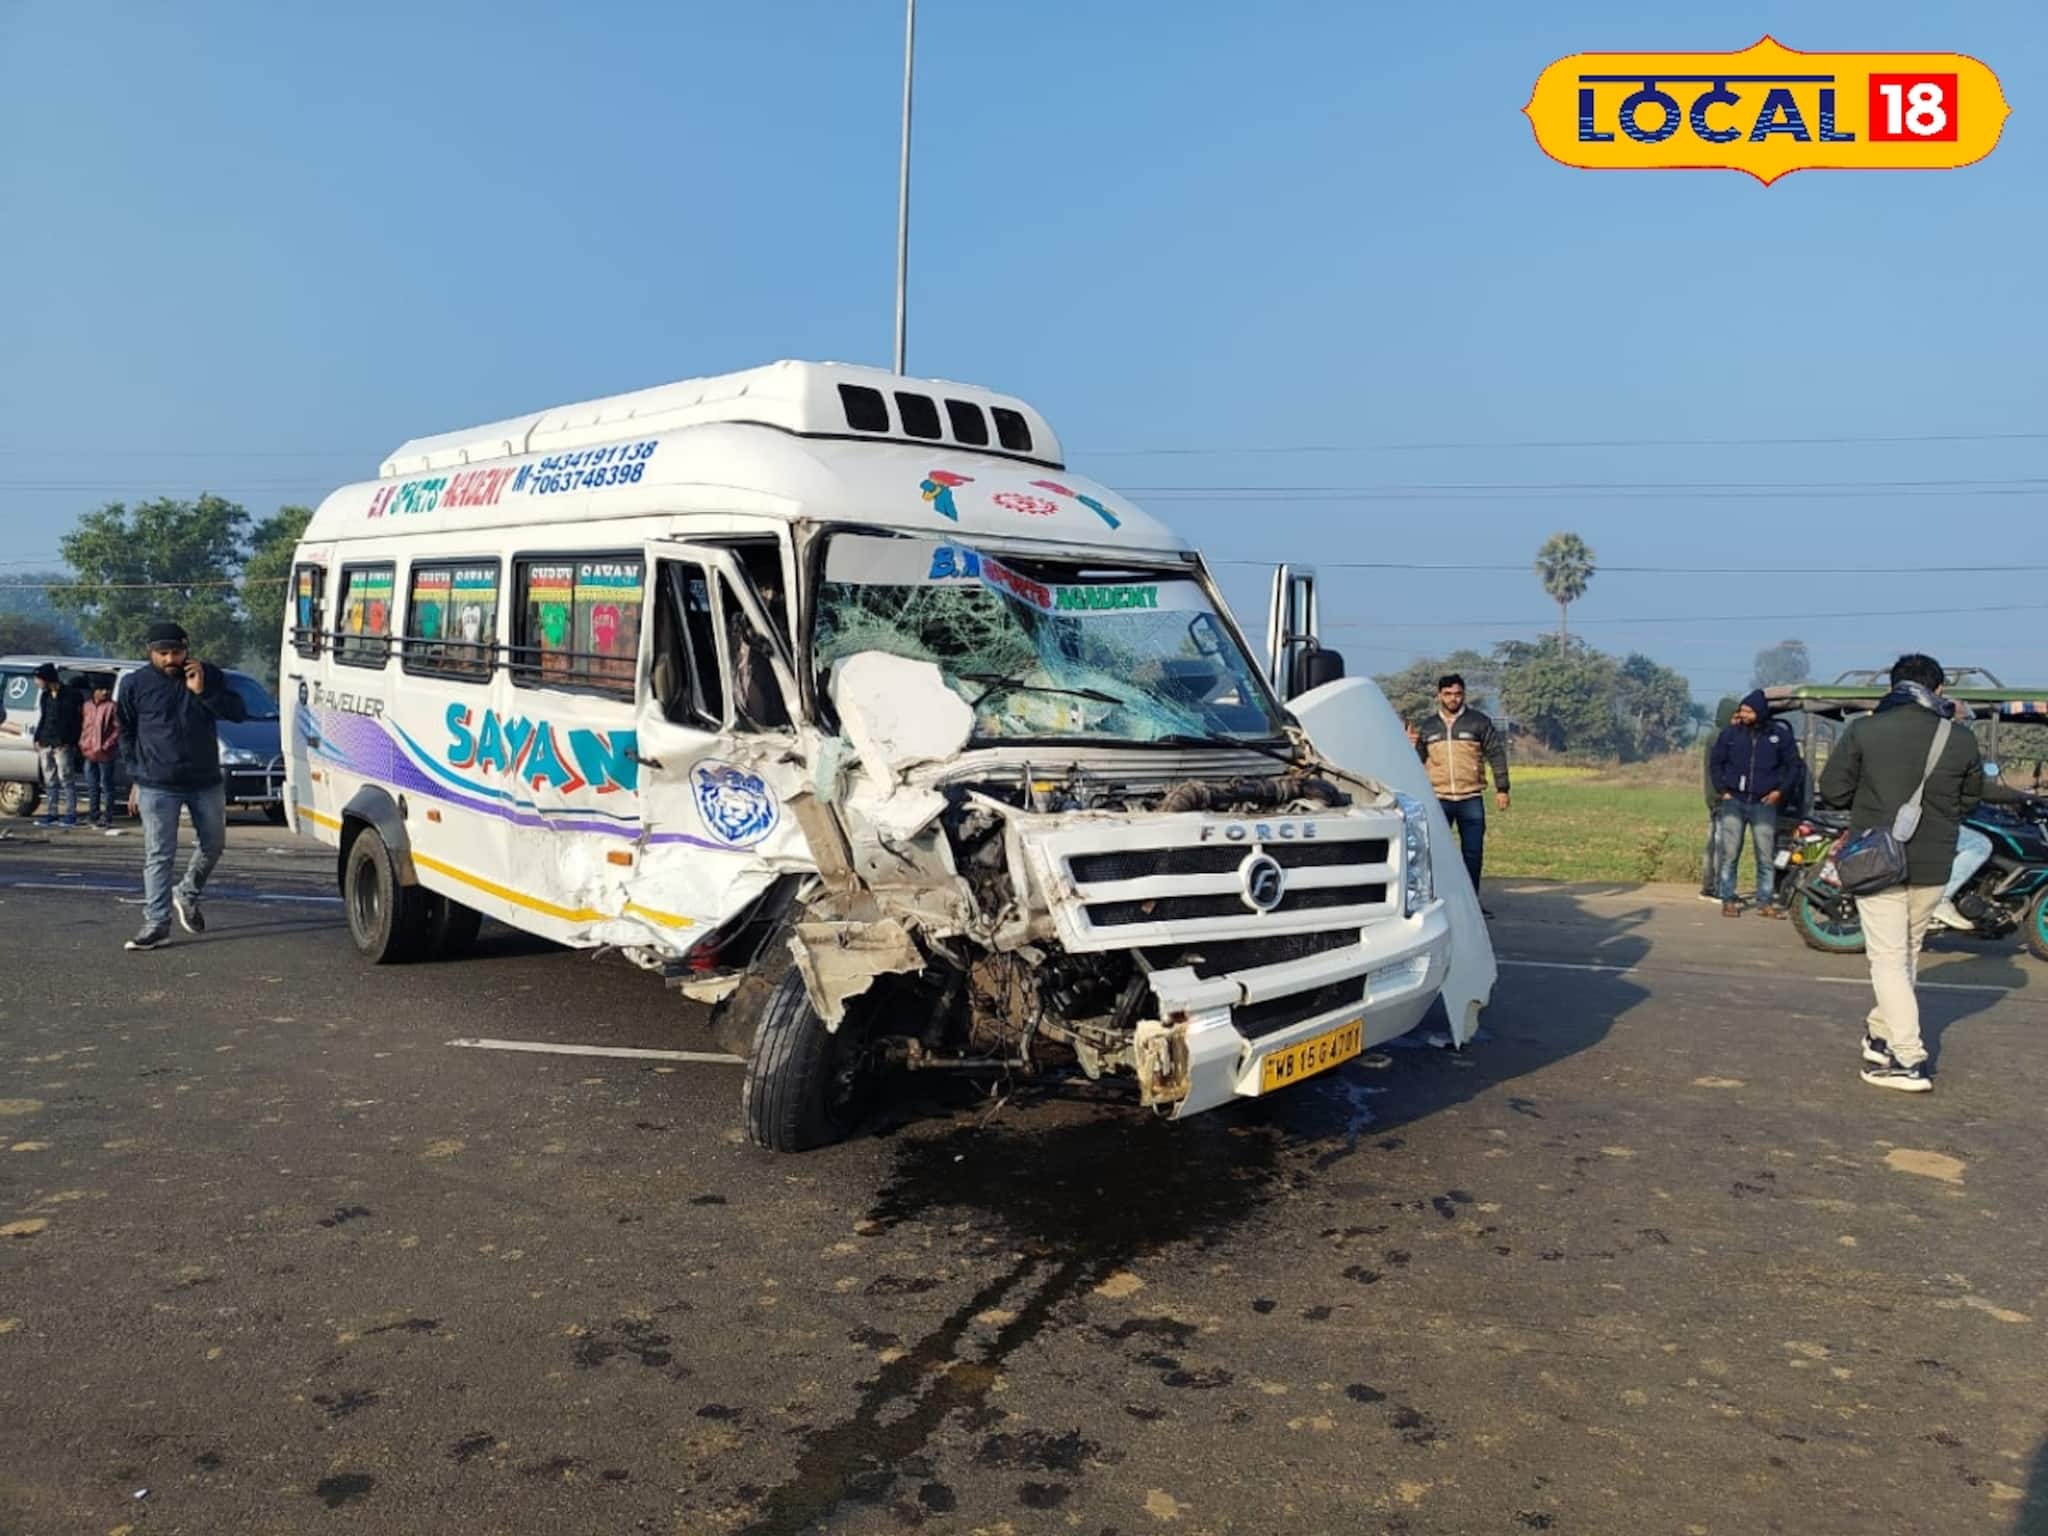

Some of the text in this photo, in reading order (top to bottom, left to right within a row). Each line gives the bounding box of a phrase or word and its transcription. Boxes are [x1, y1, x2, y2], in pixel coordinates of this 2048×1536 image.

[1055, 586, 1158, 610] ACADEMY
[446, 703, 639, 793] SAYAN
[1200, 822, 1316, 841] FORCE
